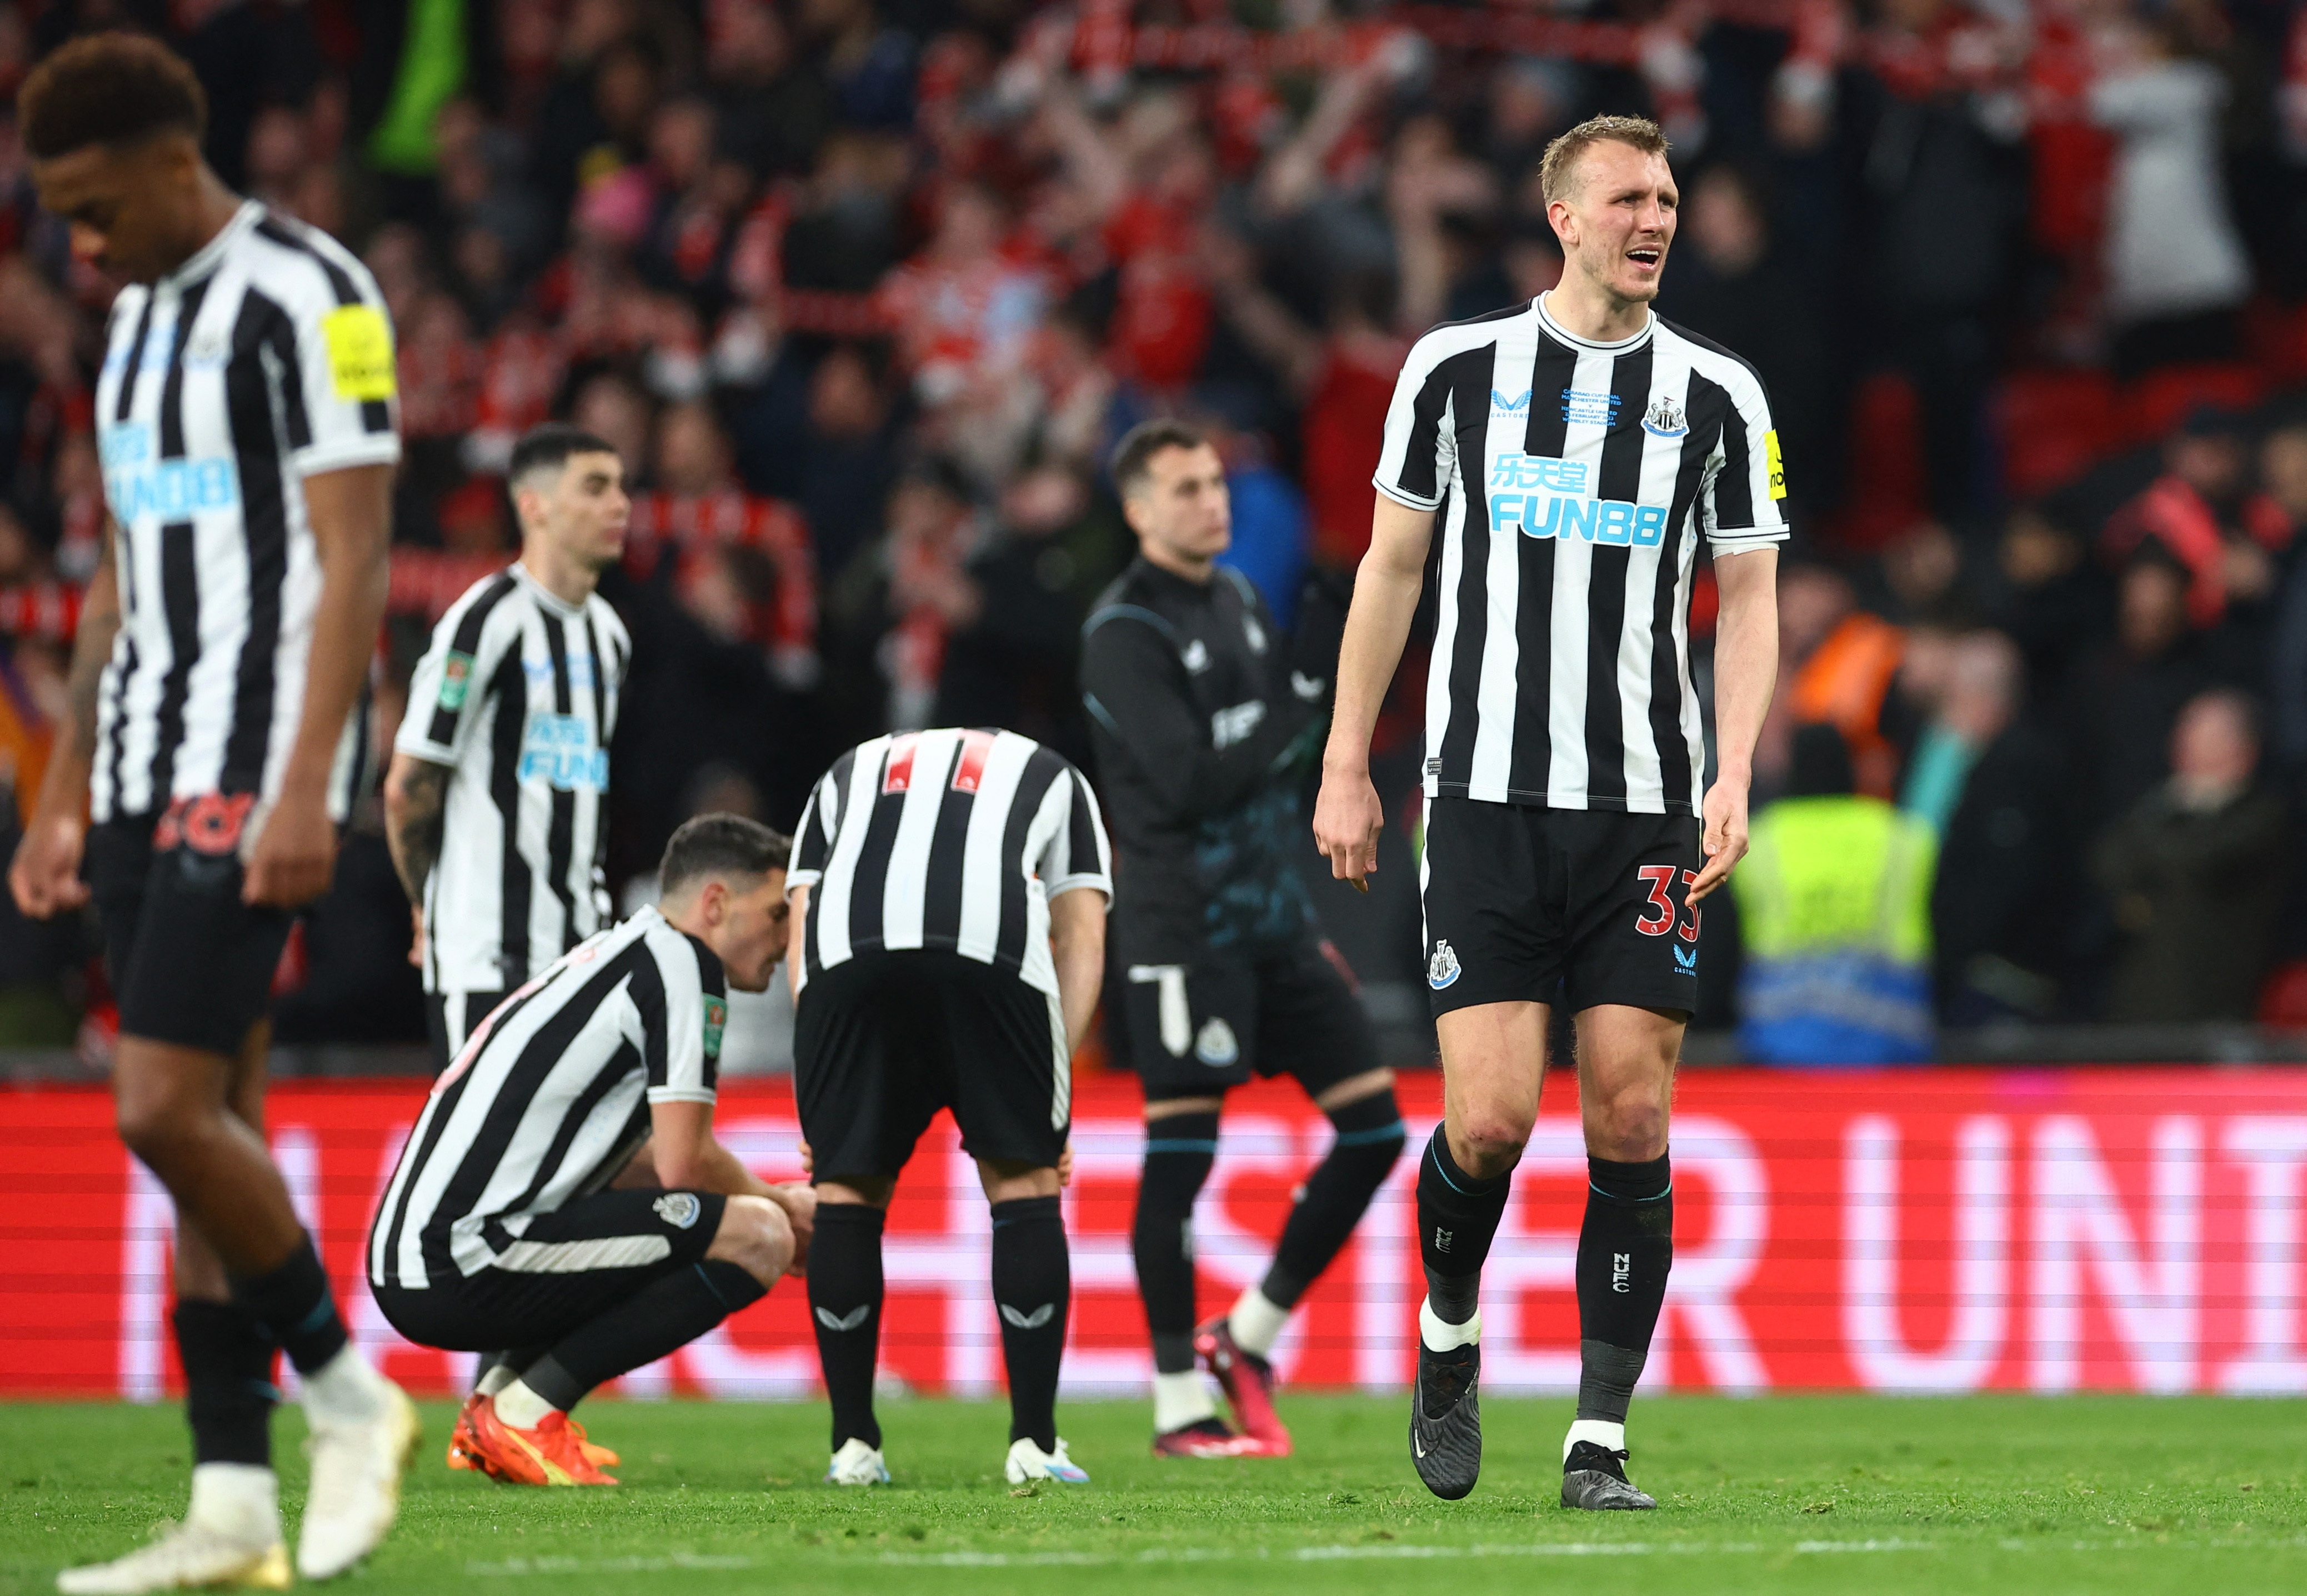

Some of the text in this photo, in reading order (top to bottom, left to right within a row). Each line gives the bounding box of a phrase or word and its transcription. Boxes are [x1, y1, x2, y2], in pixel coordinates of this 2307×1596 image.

[1561, 394, 1598, 403] MANCHESTER
[1490, 453, 1588, 493] 乐天堂
[1490, 494, 1667, 546] FUN88
[1635, 865, 1700, 942] 33
[1612, 1253, 1629, 1293] NUFC
[1840, 1114, 2307, 1398] UNI
